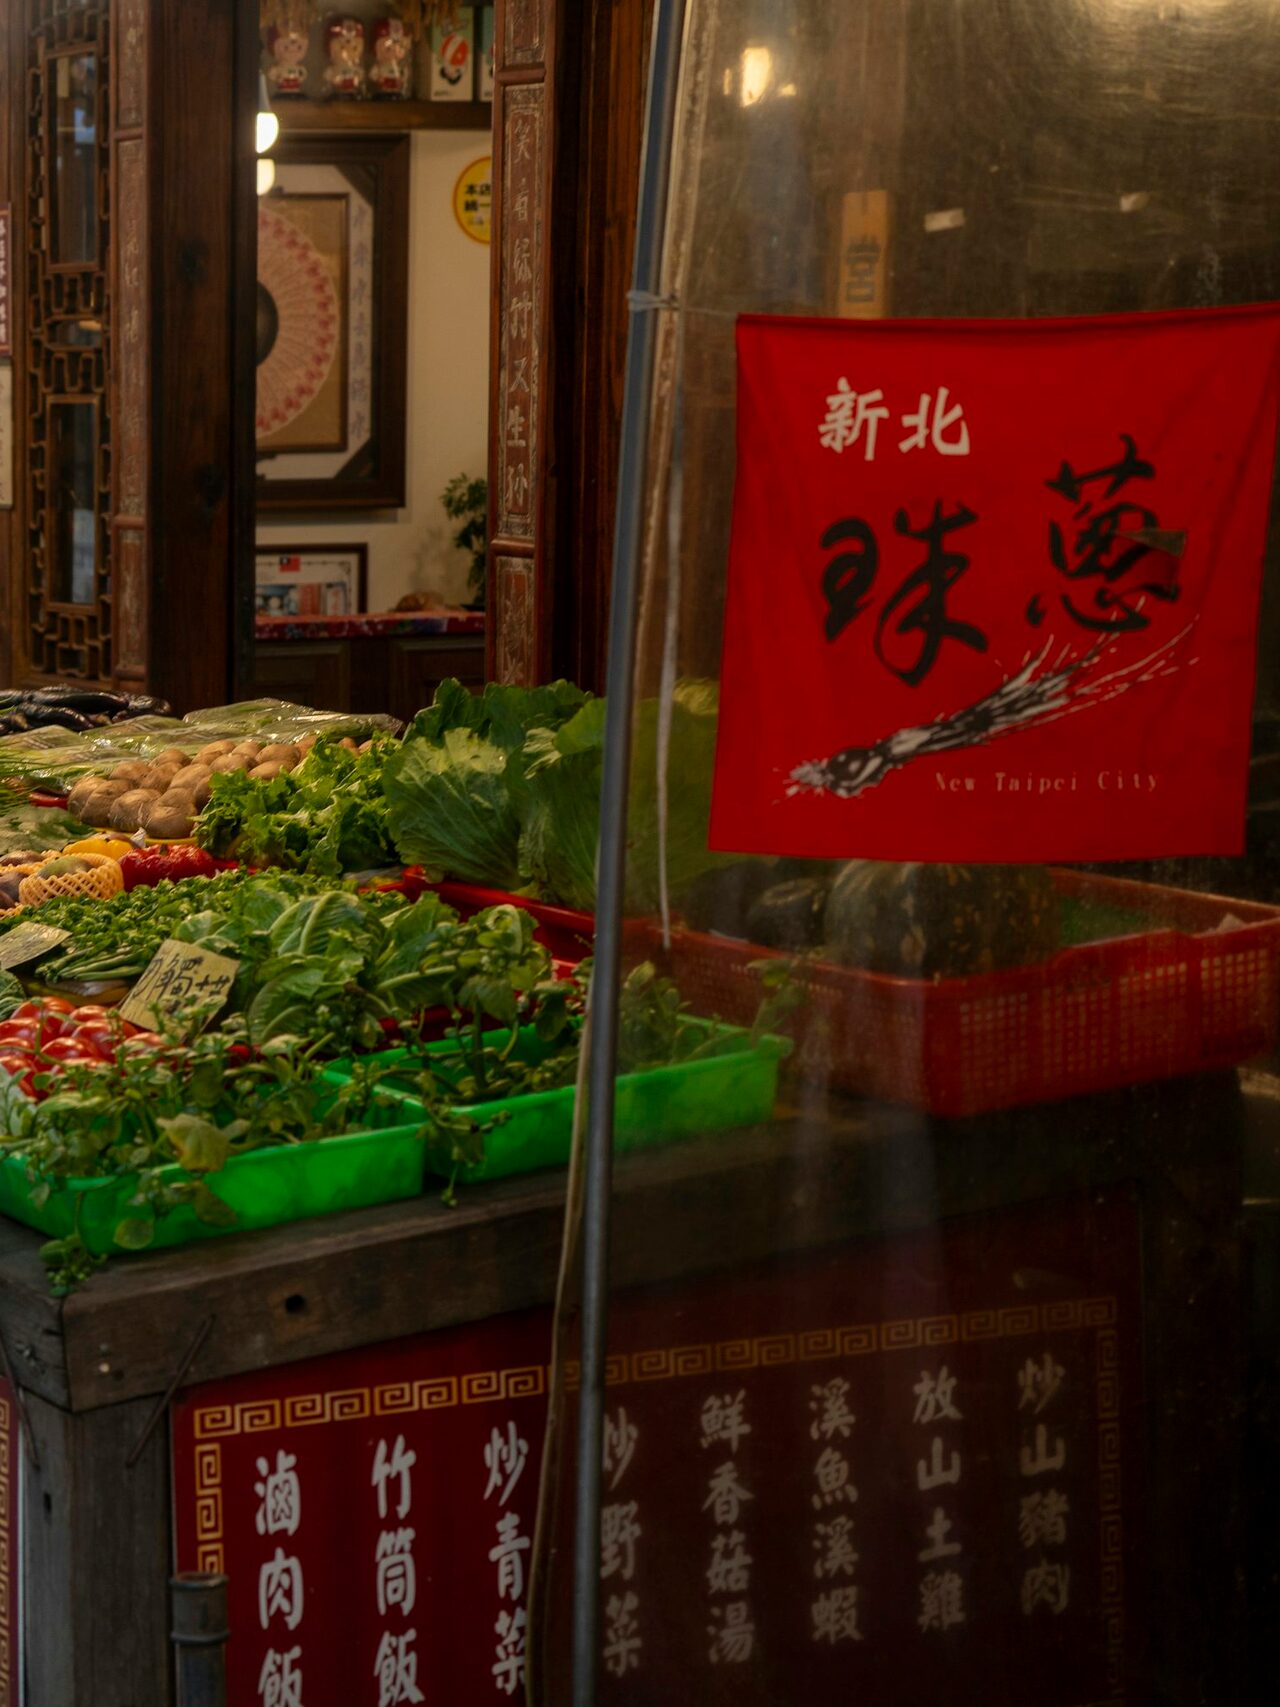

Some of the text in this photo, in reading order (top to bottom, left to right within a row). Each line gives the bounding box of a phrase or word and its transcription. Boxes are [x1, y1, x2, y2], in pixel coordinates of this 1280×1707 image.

[817, 376, 971, 462] 新北
[935, 769, 1160, 796] New Taipei City
[253, 1448, 306, 1707] 滷肉飯
[370, 1433, 426, 1707] 竹筒飯
[483, 1419, 531, 1696] 炒青菜
[600, 1405, 643, 1678] 炒野菜
[699, 1387, 756, 1664] 鮮香菇湯
[808, 1376, 863, 1645] 溪魚溪蝦
[911, 1364, 967, 1633] 放山土雞
[1015, 1351, 1071, 1616] 炒山豬肉
